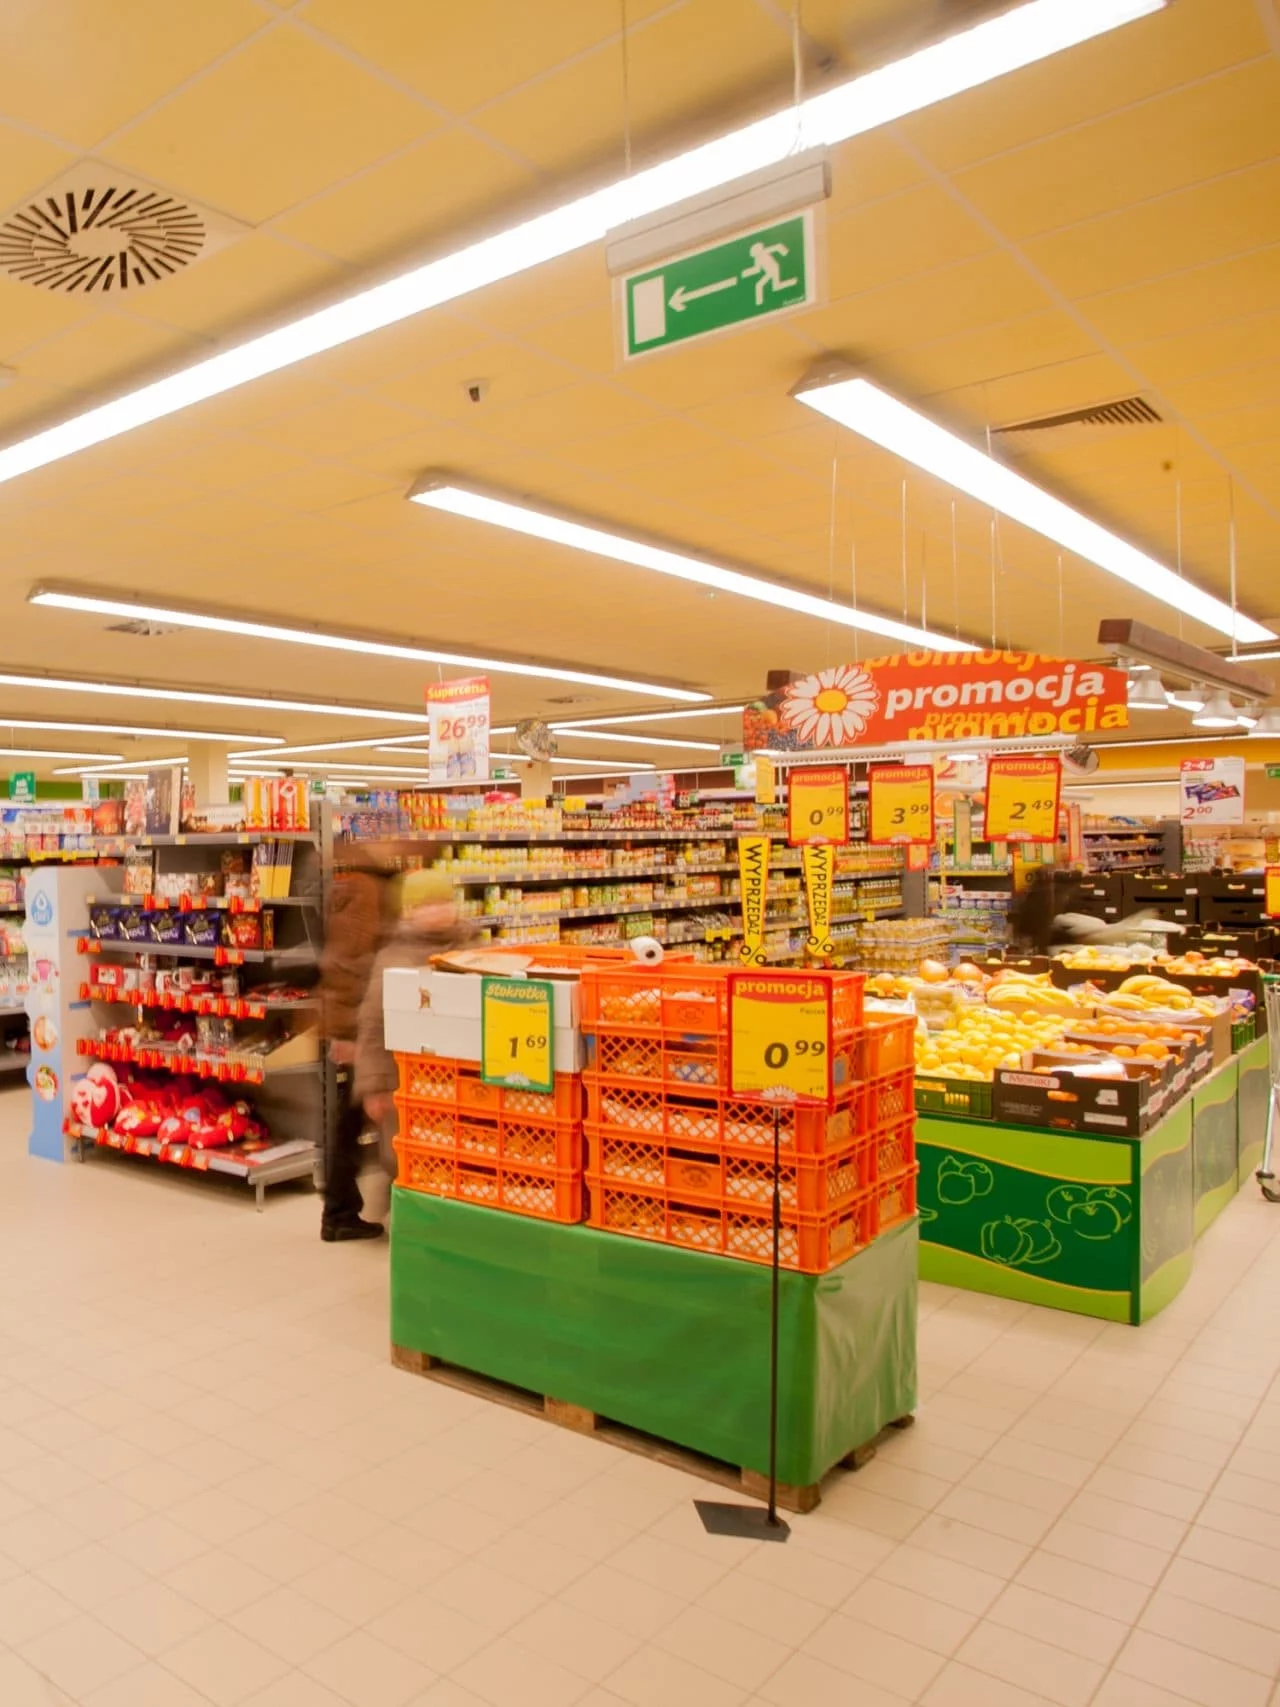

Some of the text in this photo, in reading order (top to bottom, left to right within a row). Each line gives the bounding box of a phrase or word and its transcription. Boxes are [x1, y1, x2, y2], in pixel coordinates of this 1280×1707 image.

[884, 664, 1106, 720] promocja
[991, 760, 1055, 774] promocja
[735, 980, 825, 999] promocja
